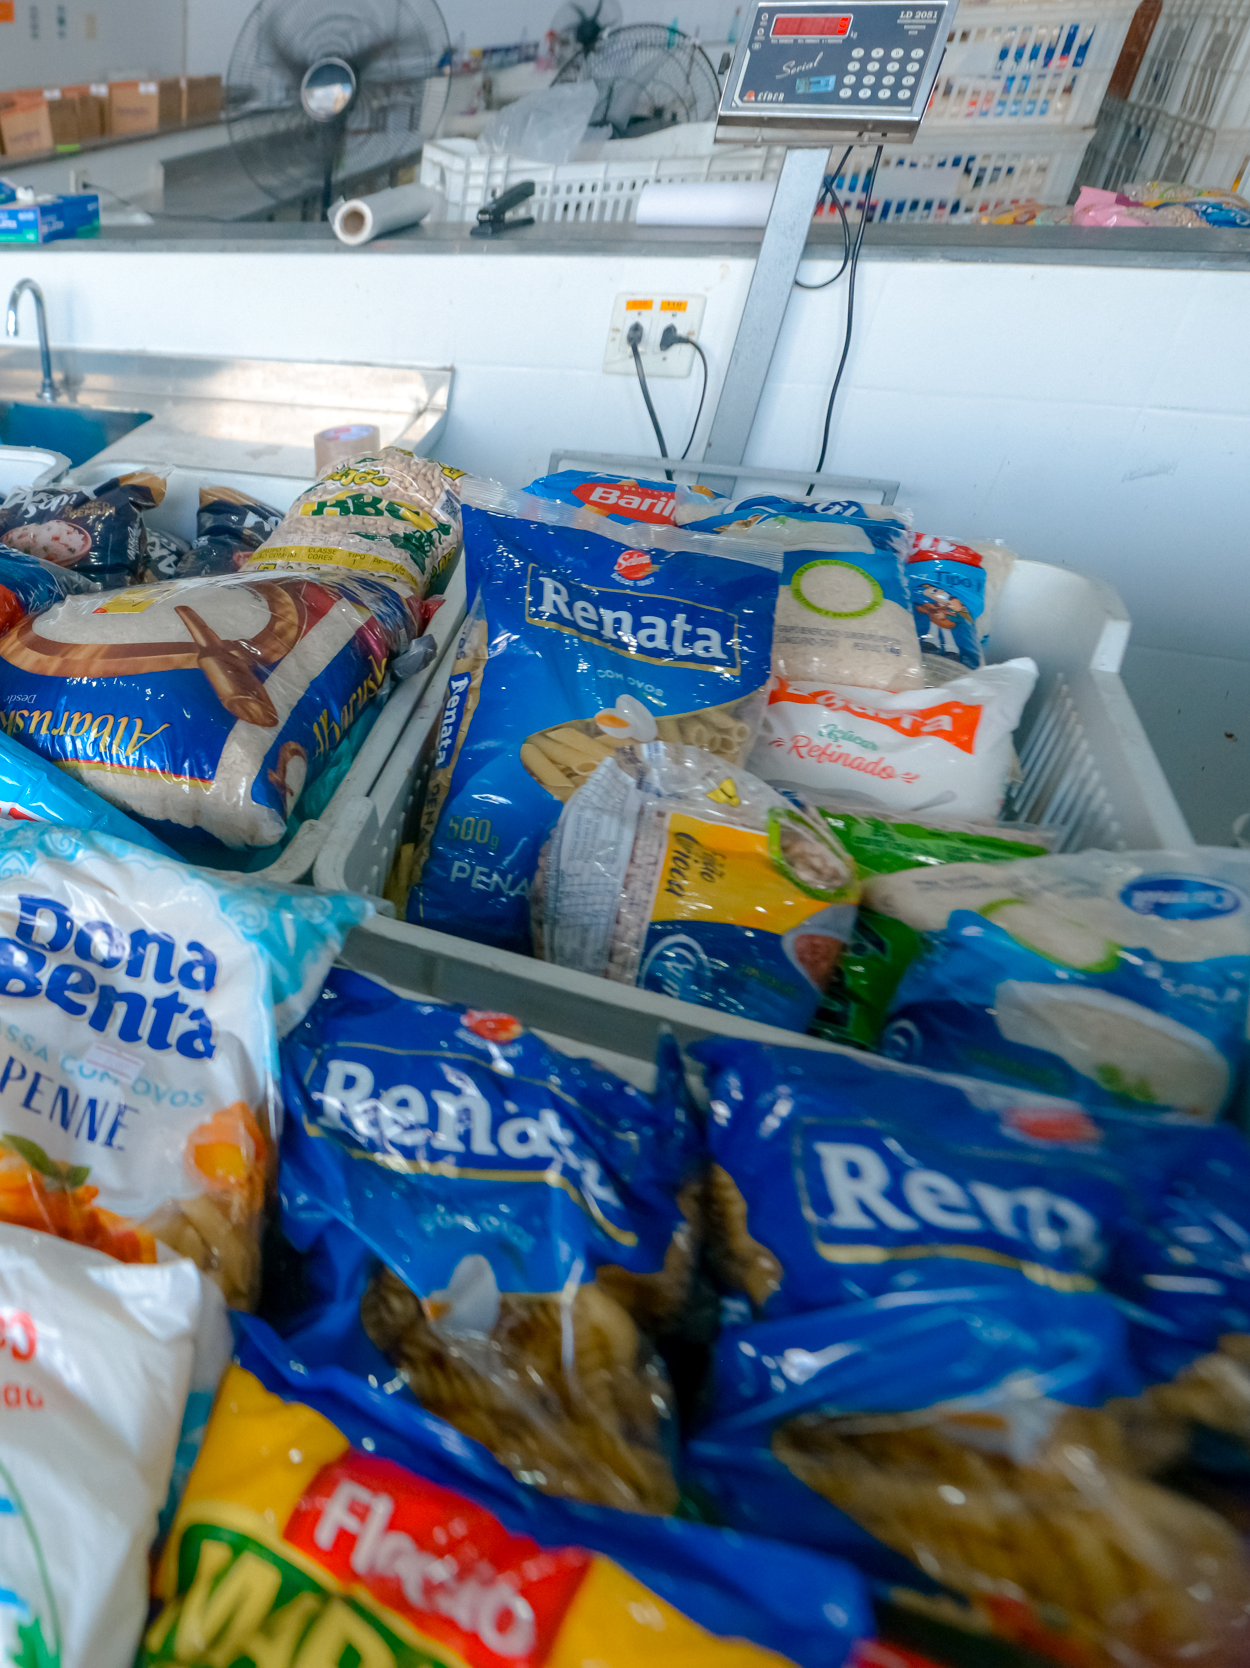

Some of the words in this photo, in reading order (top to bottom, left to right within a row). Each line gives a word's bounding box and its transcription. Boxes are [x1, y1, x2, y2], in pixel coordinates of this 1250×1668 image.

[837, 17, 849, 34] 5
[776, 52, 824, 79] Serial
[589, 487, 676, 521] Baril
[308, 547, 337, 555] CLASSE
[348, 552, 366, 561] TIPO
[934, 571, 971, 588] Tipo
[536, 575, 729, 661] Renata
[627, 675, 666, 699] OVOS
[435, 677, 470, 767] Renata
[788, 734, 897, 780] Refinado
[14, 891, 220, 994] Dona
[131, 1077, 206, 1108] OVOS
